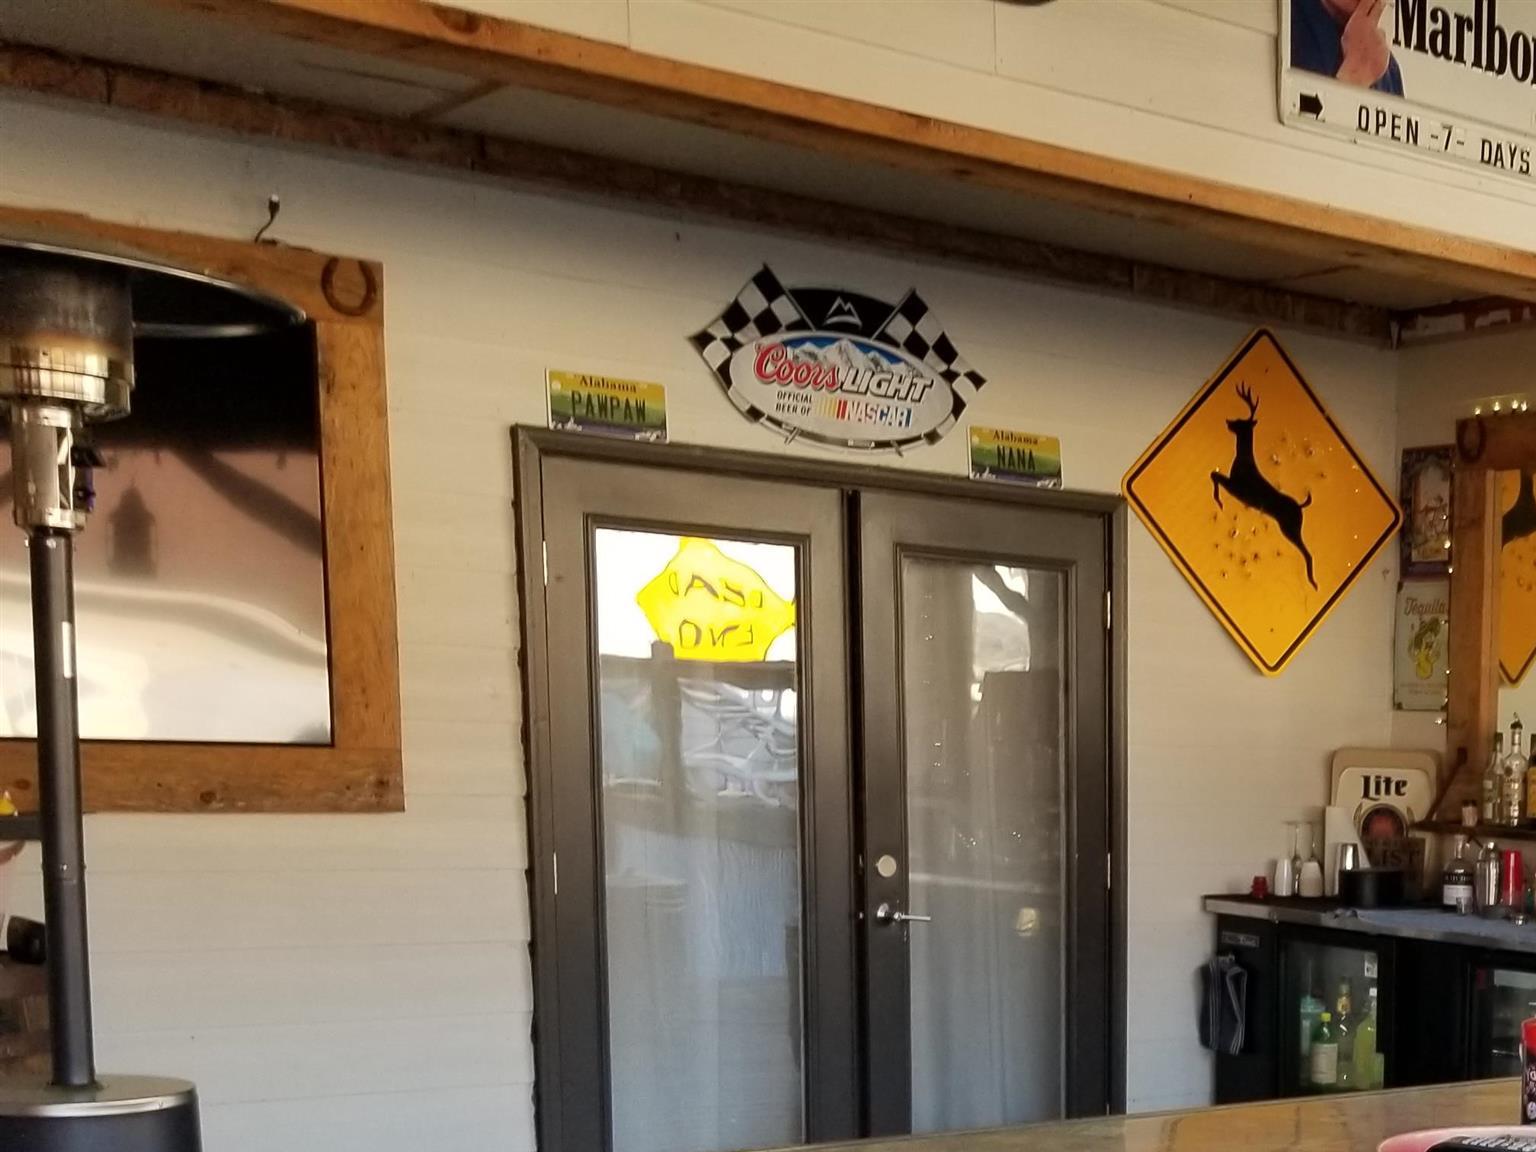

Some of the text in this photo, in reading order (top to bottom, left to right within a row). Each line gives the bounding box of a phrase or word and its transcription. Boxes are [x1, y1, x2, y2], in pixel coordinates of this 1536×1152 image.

[1357, 105, 1420, 146] OPEN
[1480, 138, 1531, 176] DAYS
[579, 375, 637, 393] Alabama
[754, 342, 934, 404] Coors LIGHT
[571, 390, 646, 422] PAWPAW
[775, 403, 811, 416] BEER OF
[776, 390, 812, 404] OFFICIAL
[847, 400, 912, 428] NASCAR
[993, 429, 1038, 445] Alabama
[997, 444, 1035, 472] NANA
[1361, 775, 1408, 801] Lite
